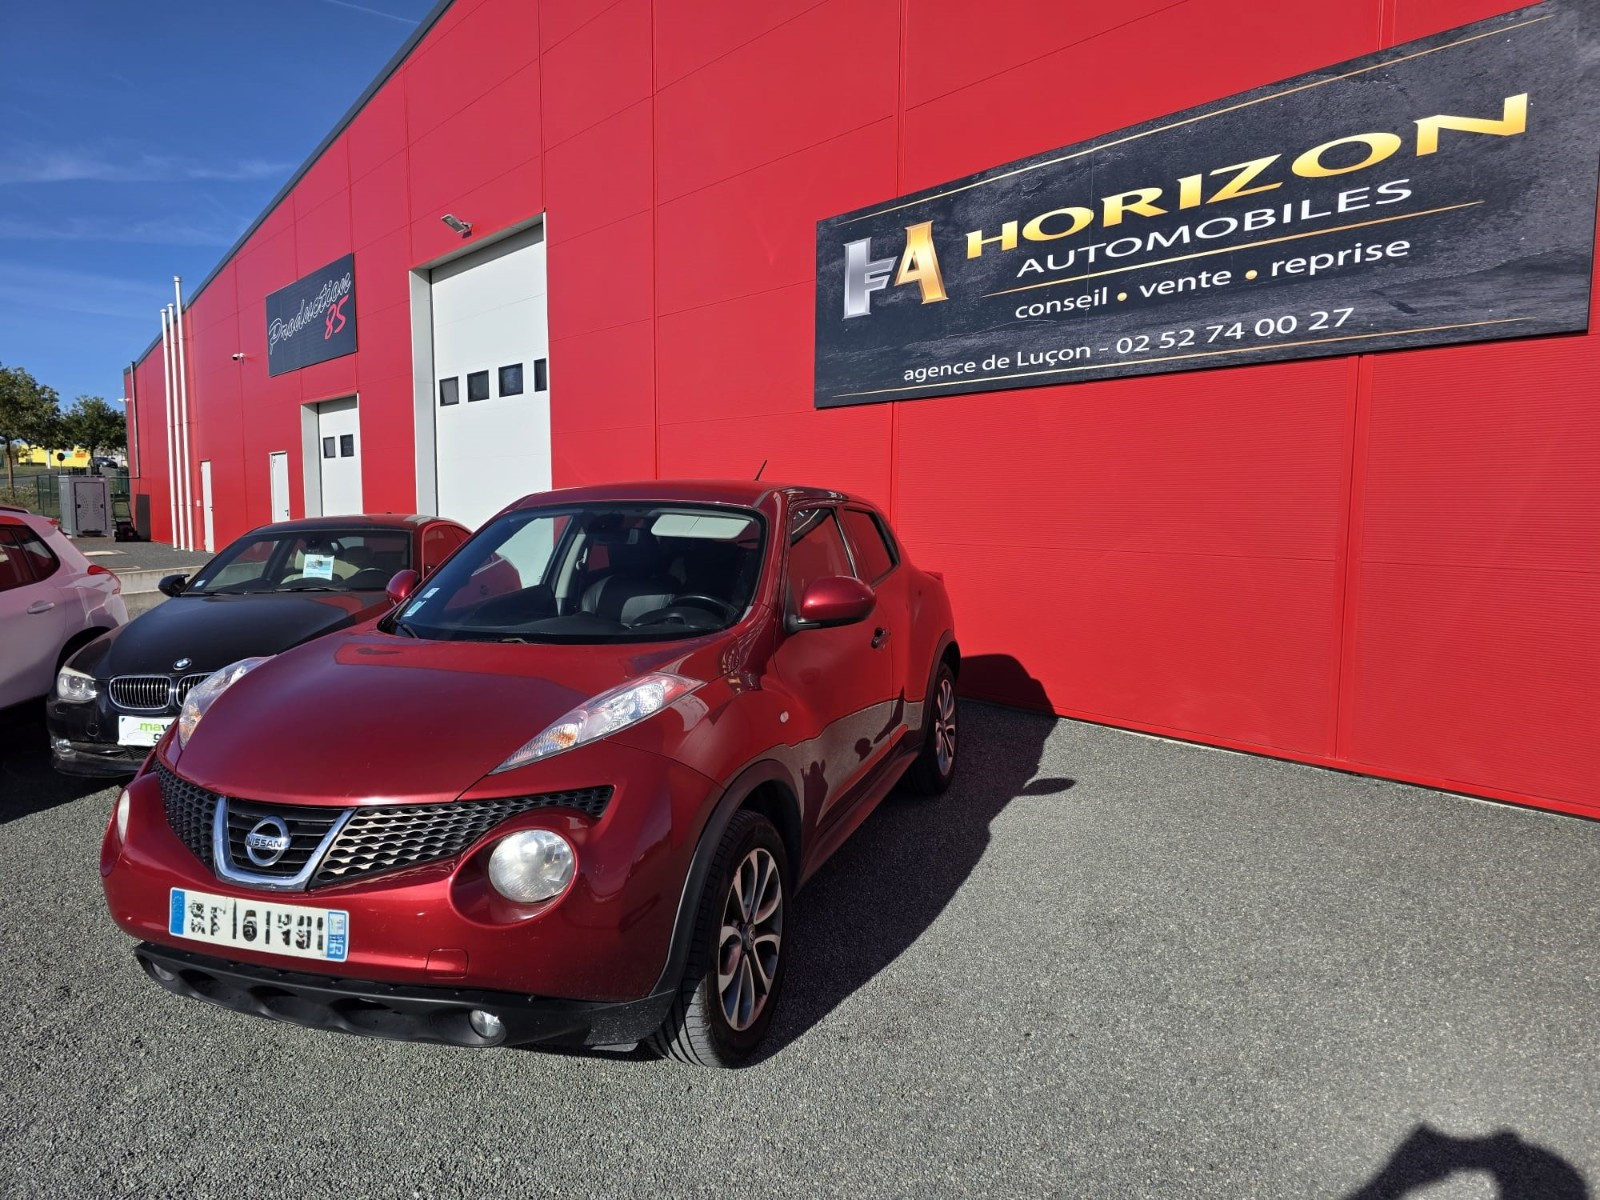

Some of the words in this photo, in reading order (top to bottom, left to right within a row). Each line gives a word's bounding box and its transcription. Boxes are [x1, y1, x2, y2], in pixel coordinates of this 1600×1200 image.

[965, 92, 1529, 260] HORIZON
[1016, 178, 1413, 278] AUTOMOBILES
[324, 294, 350, 340] 85
[1014, 286, 1108, 320] conseil
[1138, 269, 1232, 299] vente
[1271, 239, 1411, 276] reprise
[903, 363, 977, 384] agence
[981, 353, 1011, 372] de
[1016, 343, 1092, 367] Luçon
[1115, 335, 1151, 355] 02
[1157, 328, 1196, 349] 52
[1205, 321, 1246, 344] 74
[1253, 313, 1299, 337] 00
[1307, 307, 1355, 332] 27
[246, 837, 283, 848] NISSAN
